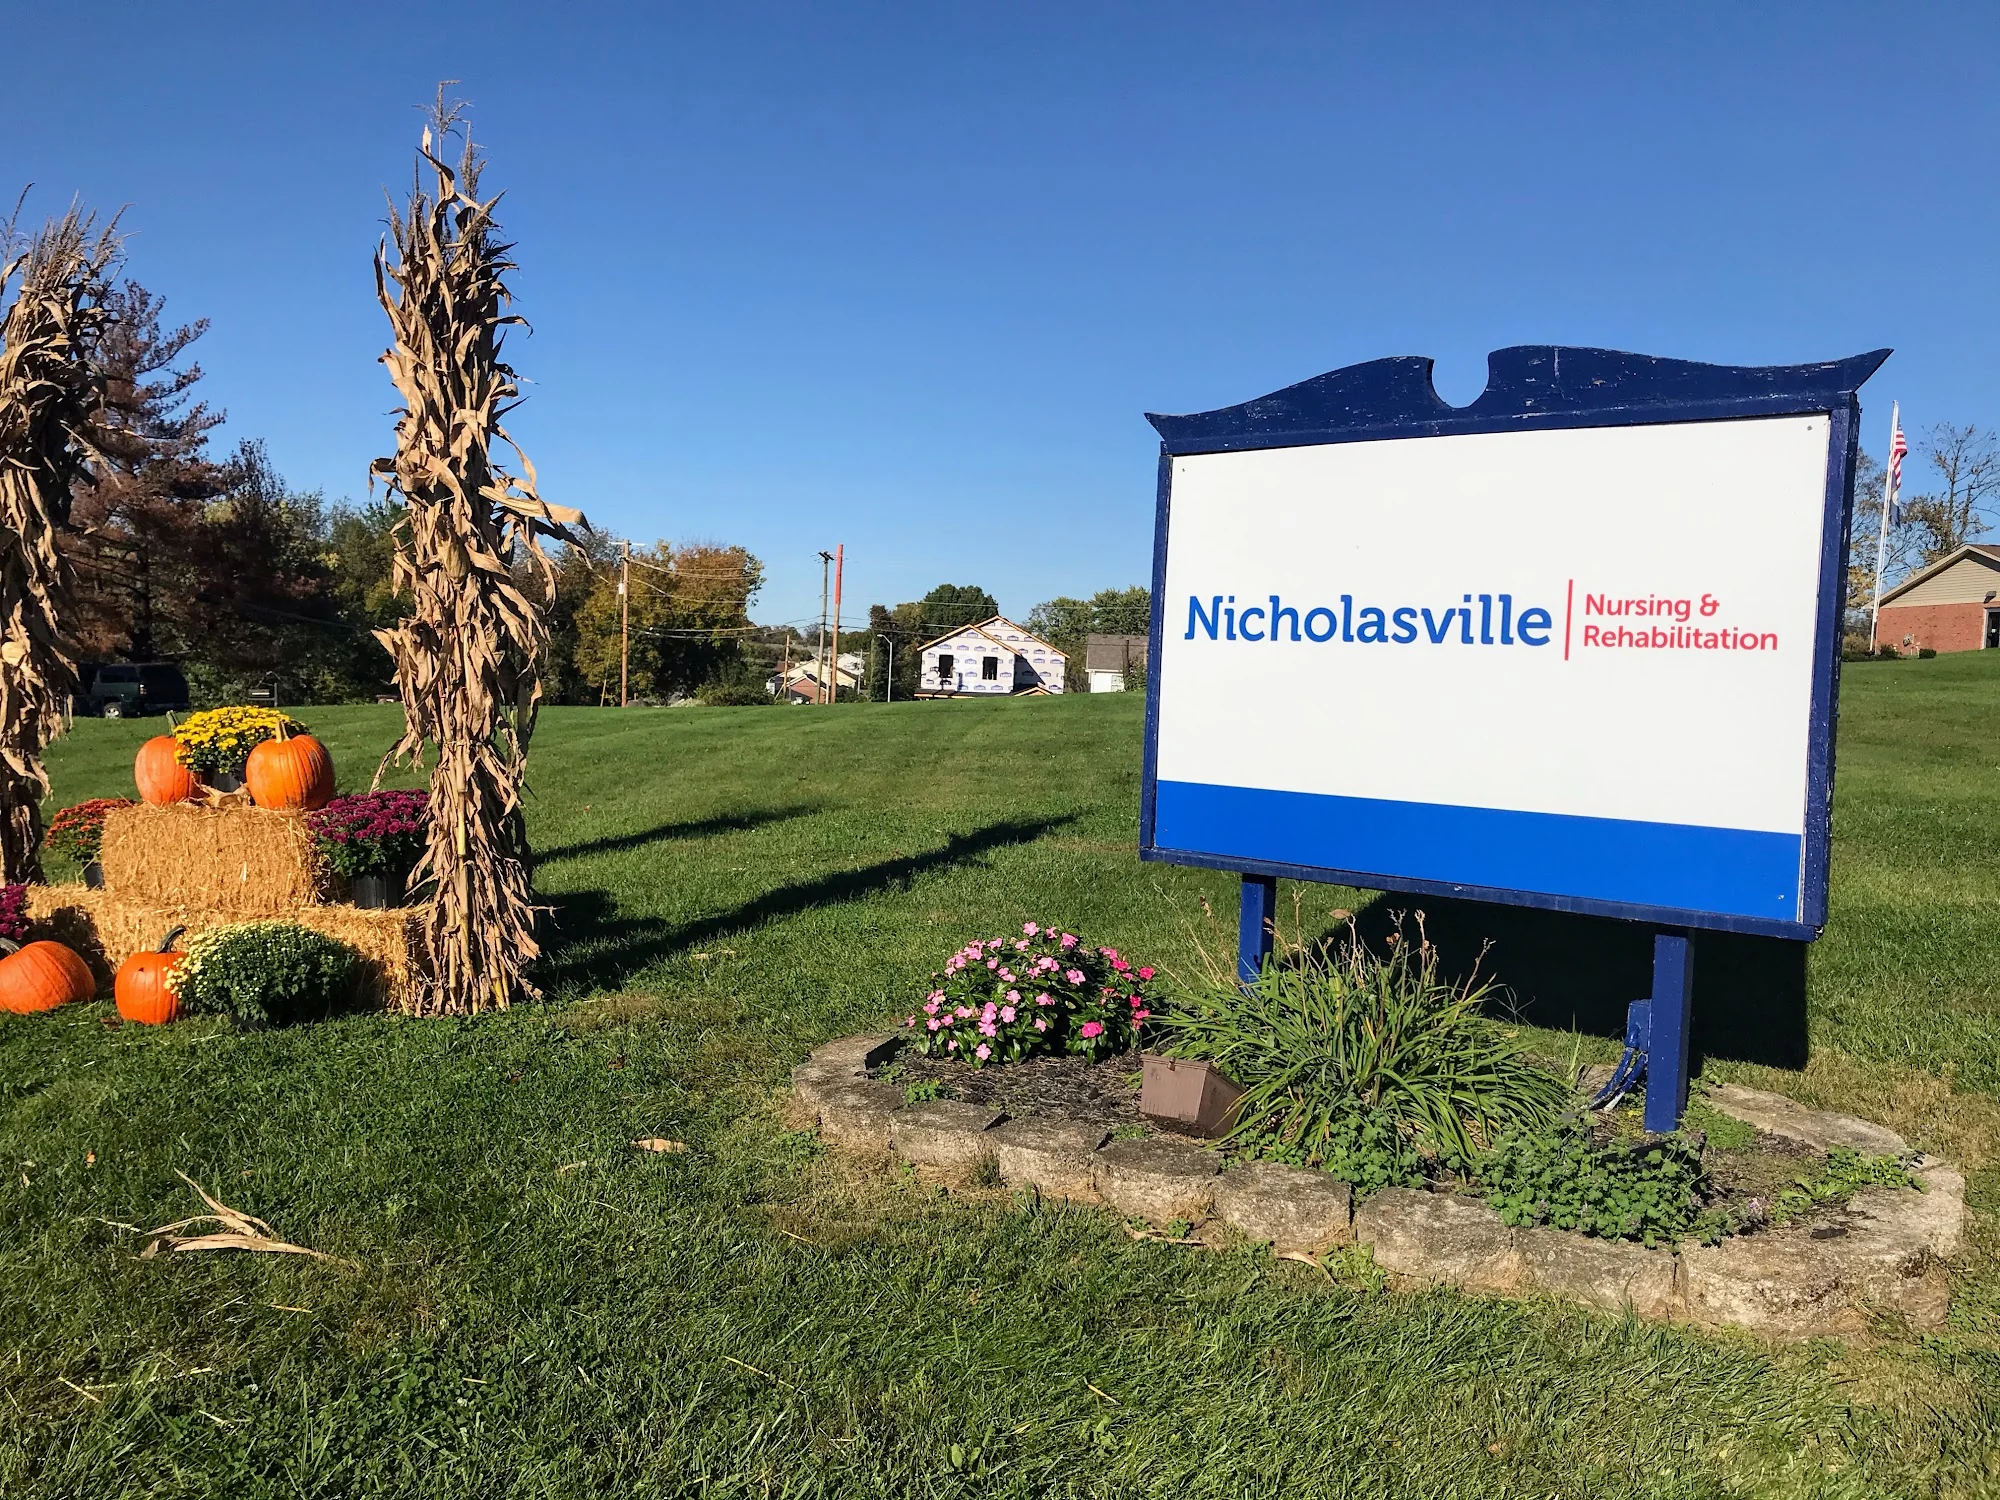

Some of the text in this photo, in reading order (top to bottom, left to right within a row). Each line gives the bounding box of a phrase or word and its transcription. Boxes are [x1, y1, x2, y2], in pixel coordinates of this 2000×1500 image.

[1183, 593, 1553, 647] Nicholasville
[1585, 593, 1720, 623] Nursing &
[1583, 624, 1779, 652] Rehabilitation
